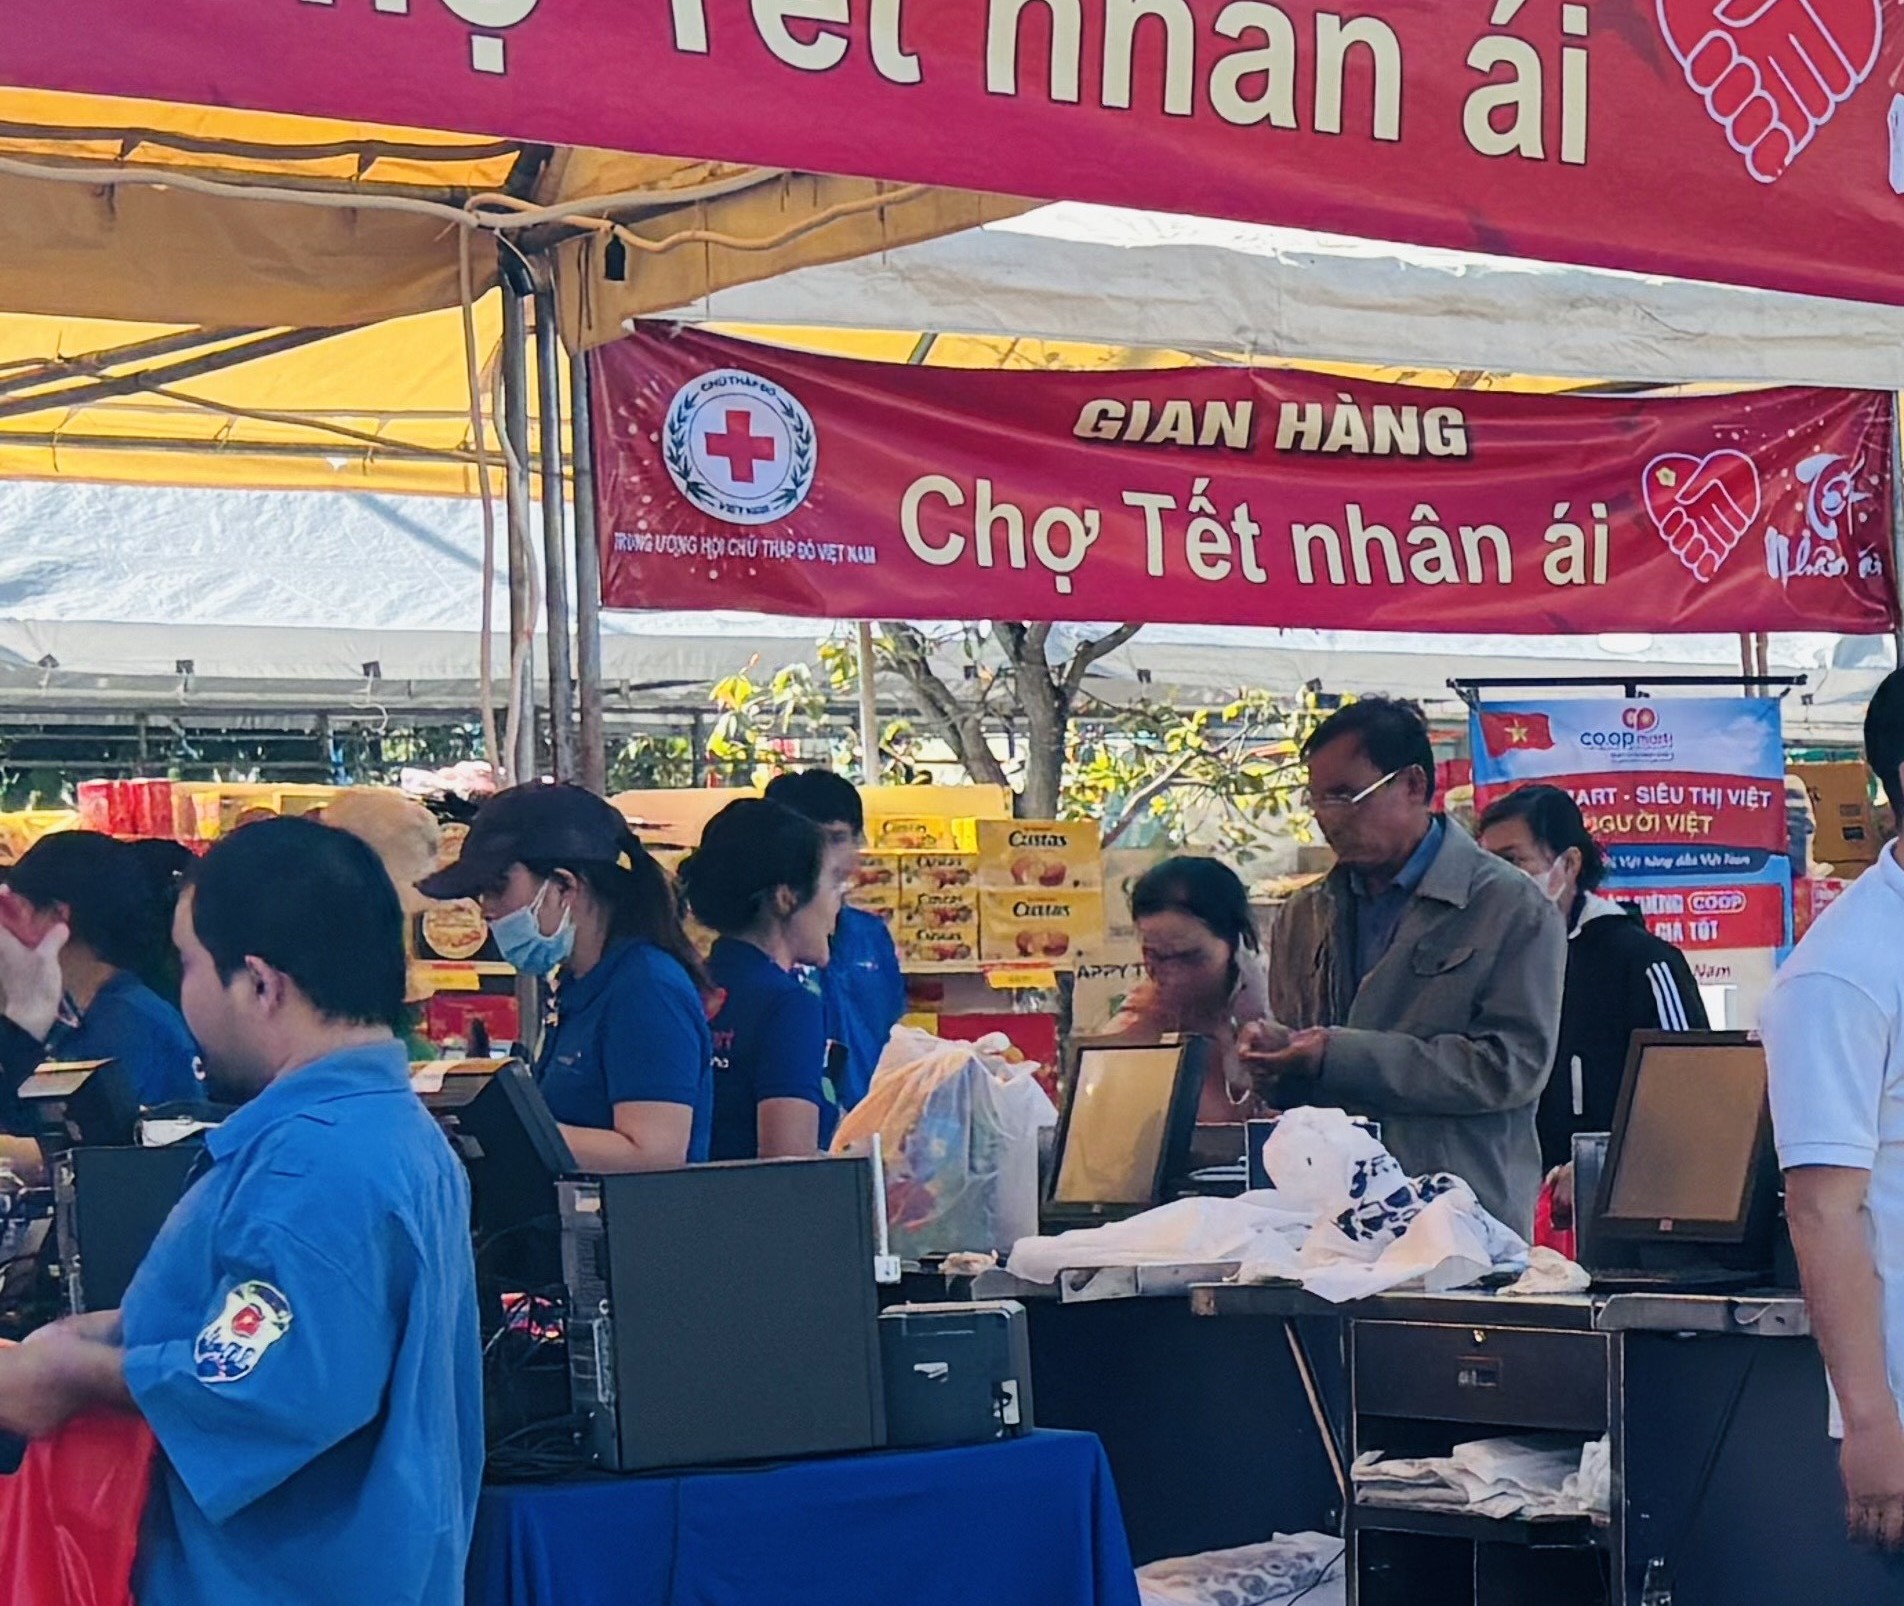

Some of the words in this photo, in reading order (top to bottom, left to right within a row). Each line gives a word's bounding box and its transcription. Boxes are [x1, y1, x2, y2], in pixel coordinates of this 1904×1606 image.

[1462, 0, 1590, 165] ái
[1073, 398, 1254, 450] GIAN
[1275, 393, 1470, 458] HÀNG
[900, 474, 1101, 595] Chợ
[1122, 478, 1268, 584] Tết
[1291, 503, 1512, 586] nhân
[1542, 502, 1610, 587] ái
[1636, 782, 1684, 805] SIÊU
[1689, 786, 1722, 809] THỊ
[1727, 785, 1772, 811] VIỆT
[1665, 810, 1713, 839] VIỆT
[1077, 963, 1129, 979] APPY
